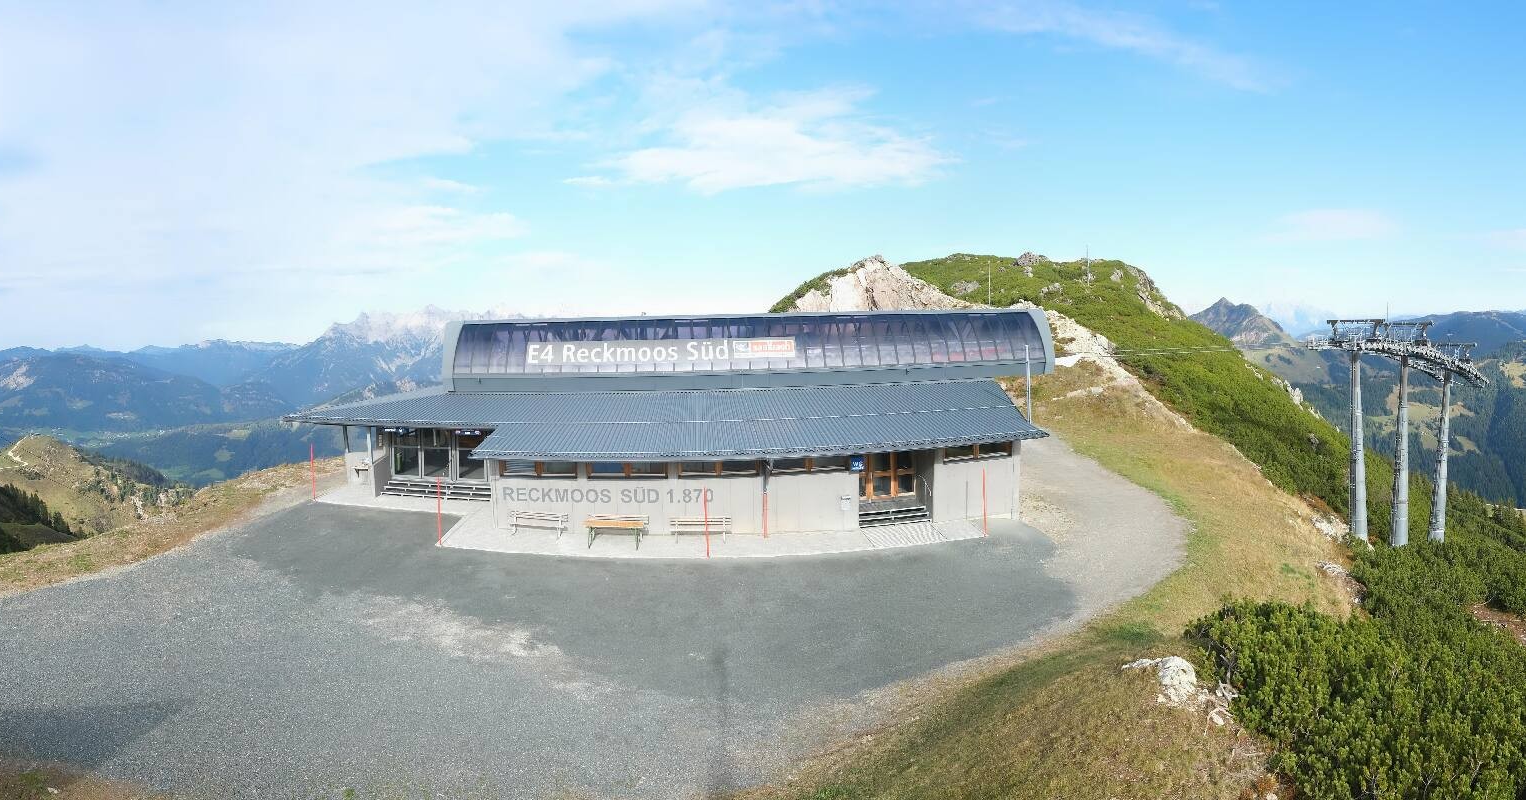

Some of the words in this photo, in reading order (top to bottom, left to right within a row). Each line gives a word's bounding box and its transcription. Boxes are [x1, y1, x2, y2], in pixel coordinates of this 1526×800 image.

[527, 343, 554, 364] E4
[562, 342, 678, 363] Reckmoos
[686, 339, 729, 361] Süd
[502, 486, 612, 504] RECKMOOS
[620, 486, 660, 504] SÜD
[666, 488, 714, 504] 1.870
